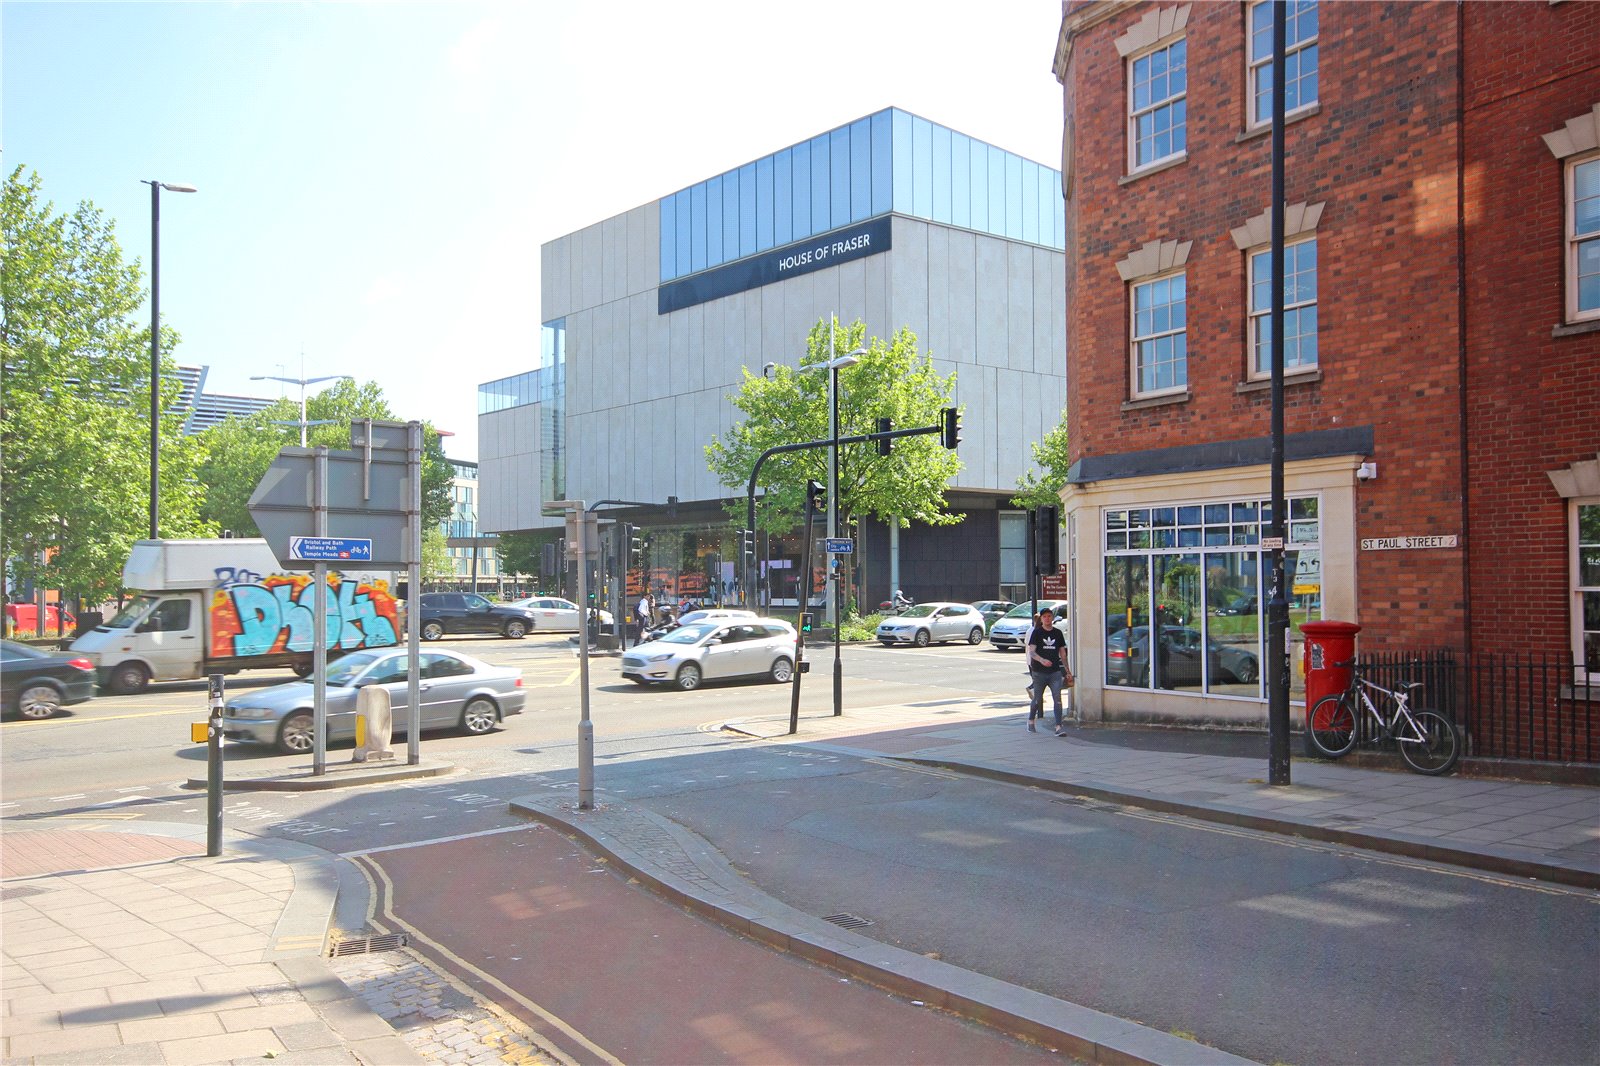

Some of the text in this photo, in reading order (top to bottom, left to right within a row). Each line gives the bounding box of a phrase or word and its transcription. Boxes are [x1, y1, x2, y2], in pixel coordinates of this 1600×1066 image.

[779, 234, 870, 271] HOUSE OF FRASER
[1378, 539, 1401, 549] PAUL
[1406, 537, 1443, 548] STREET
[1448, 537, 1454, 546] 2
